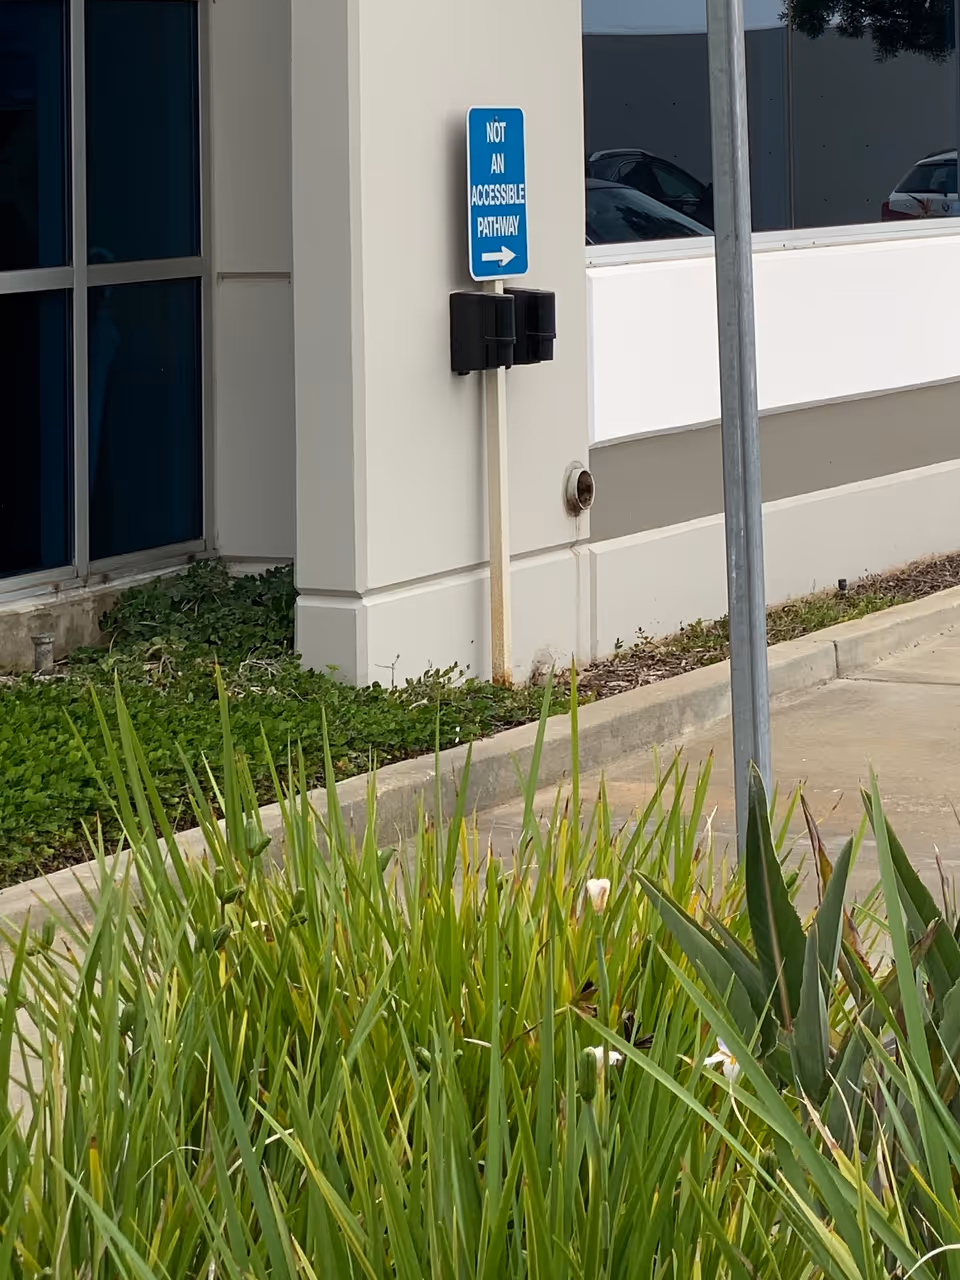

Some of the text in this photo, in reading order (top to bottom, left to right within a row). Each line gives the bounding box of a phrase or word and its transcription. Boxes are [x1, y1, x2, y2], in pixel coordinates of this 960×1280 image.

[486, 122, 506, 143] NOT
[490, 153, 505, 174] AN
[471, 184, 525, 206] ACCESSIBLE
[477, 215, 520, 238] PATHWAY
